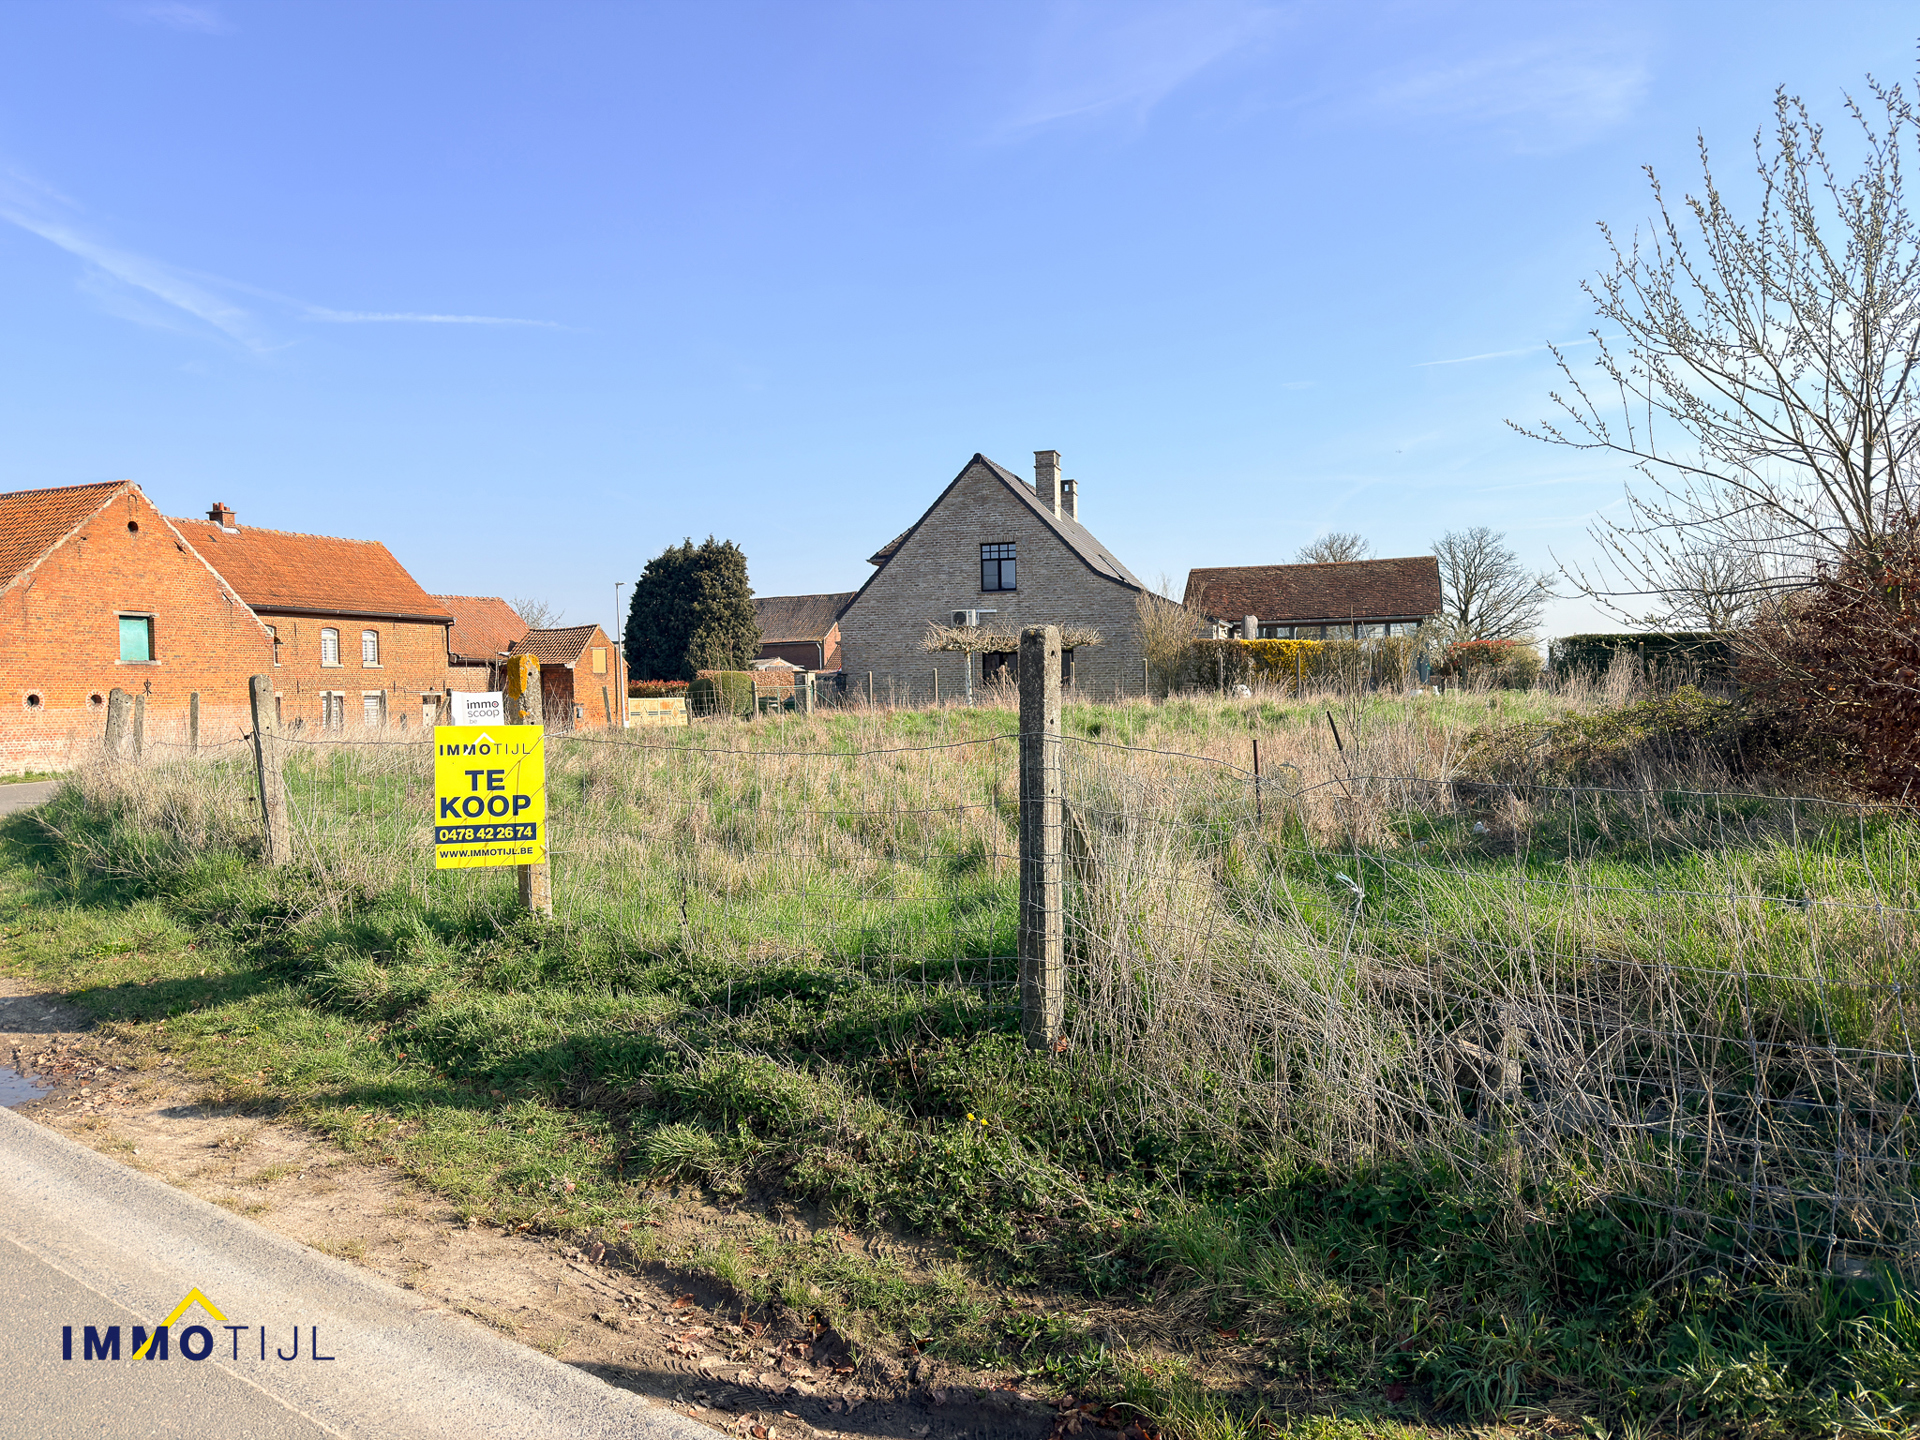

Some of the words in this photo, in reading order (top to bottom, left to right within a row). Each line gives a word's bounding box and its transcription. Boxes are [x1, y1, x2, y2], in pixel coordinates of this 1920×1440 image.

[467, 709, 500, 718] scoop
[464, 769, 506, 792] TE
[440, 795, 532, 819] KOOP
[439, 828, 474, 841] 0478
[476, 828, 494, 840] 42
[496, 827, 514, 839] 26
[516, 826, 533, 838] 74
[439, 847, 533, 858] WWW.IMMOTIJL.BE
